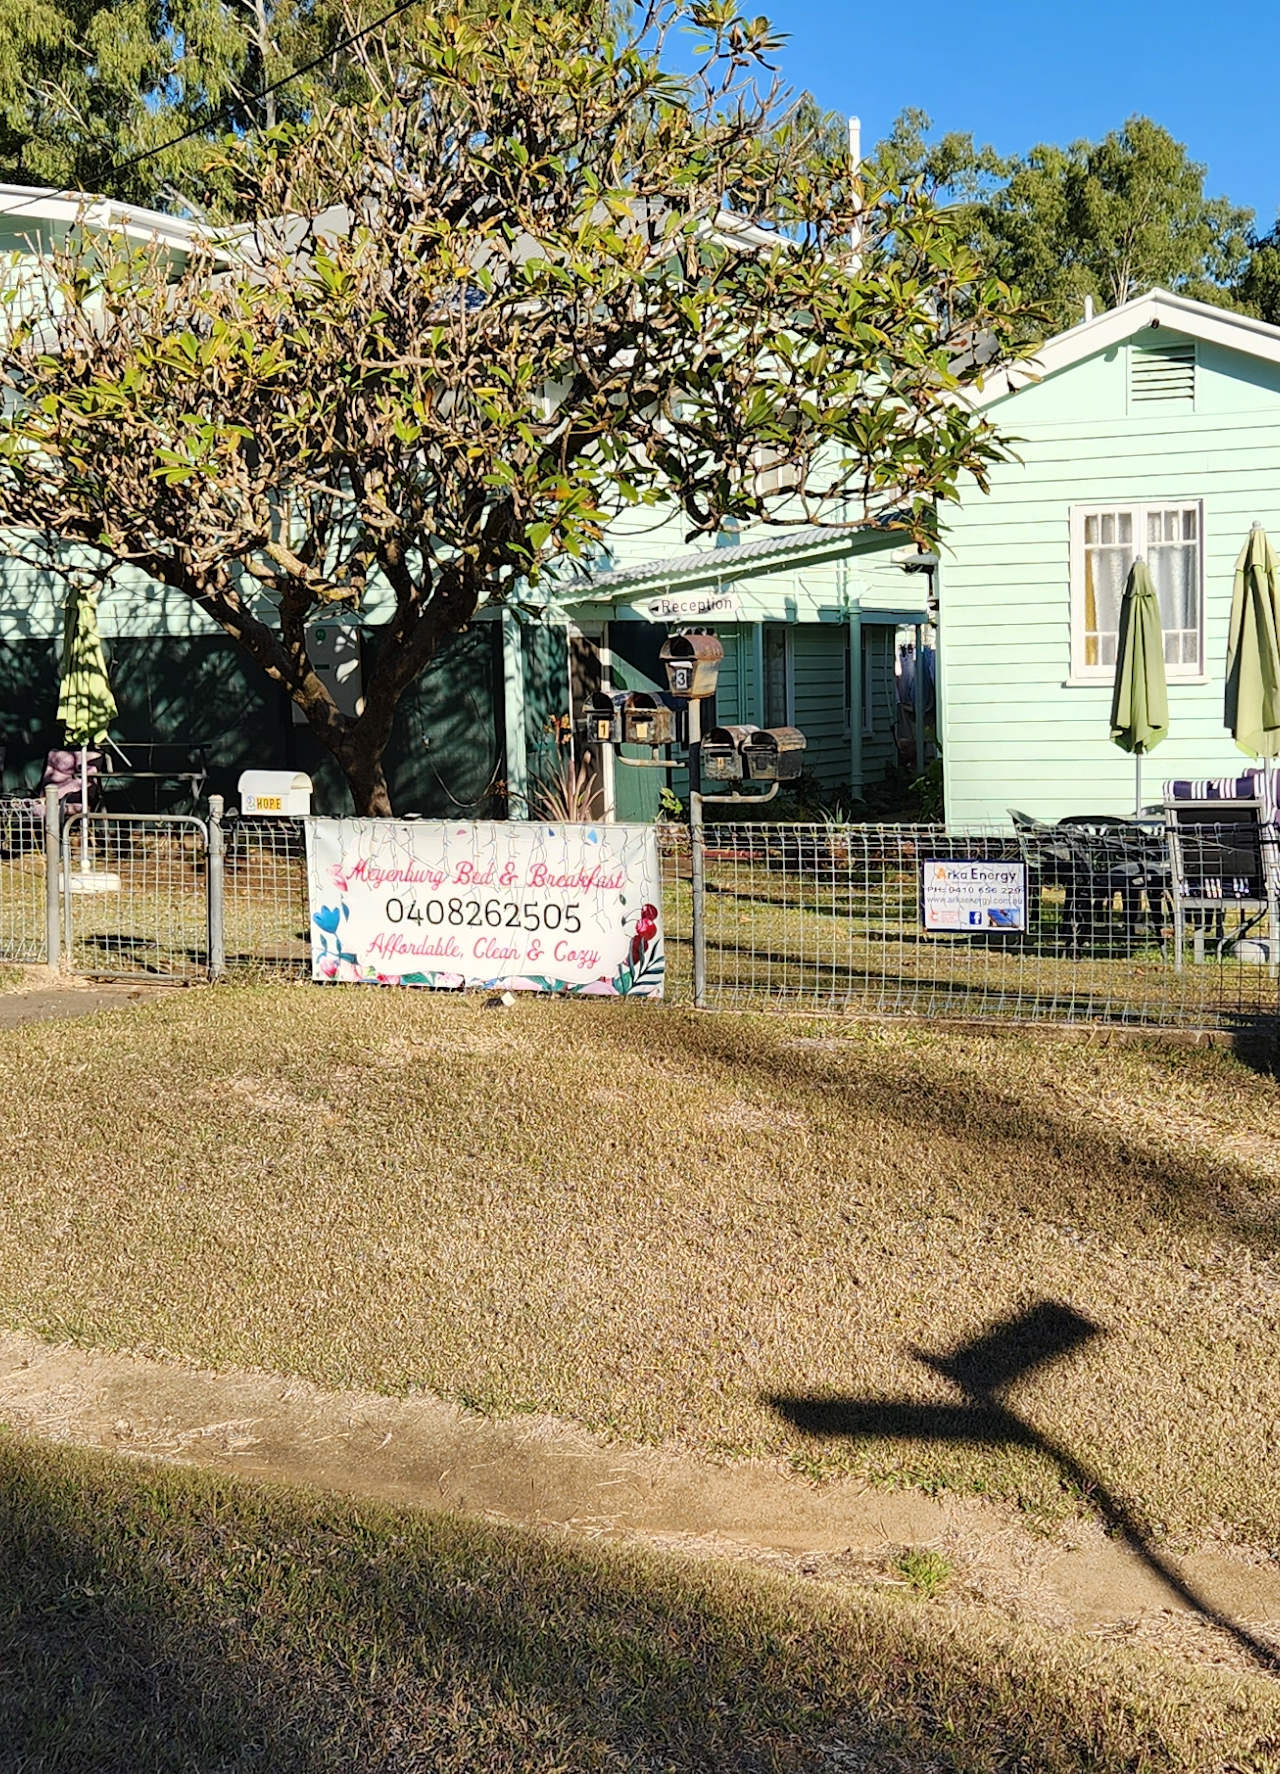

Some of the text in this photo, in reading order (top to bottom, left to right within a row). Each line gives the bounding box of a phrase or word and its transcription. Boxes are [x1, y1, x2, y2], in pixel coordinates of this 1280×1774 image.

[661, 597, 732, 614] Reception
[677, 672, 686, 686] 3
[600, 722, 606, 737] 1
[256, 797, 281, 810] HOPE
[346, 858, 625, 895] Meyenburg Bed & Breakfast
[936, 867, 1017, 883] Arka Energy
[386, 898, 581, 933] 0408262505
[366, 933, 600, 969] Affordable, Clean & Cozy
